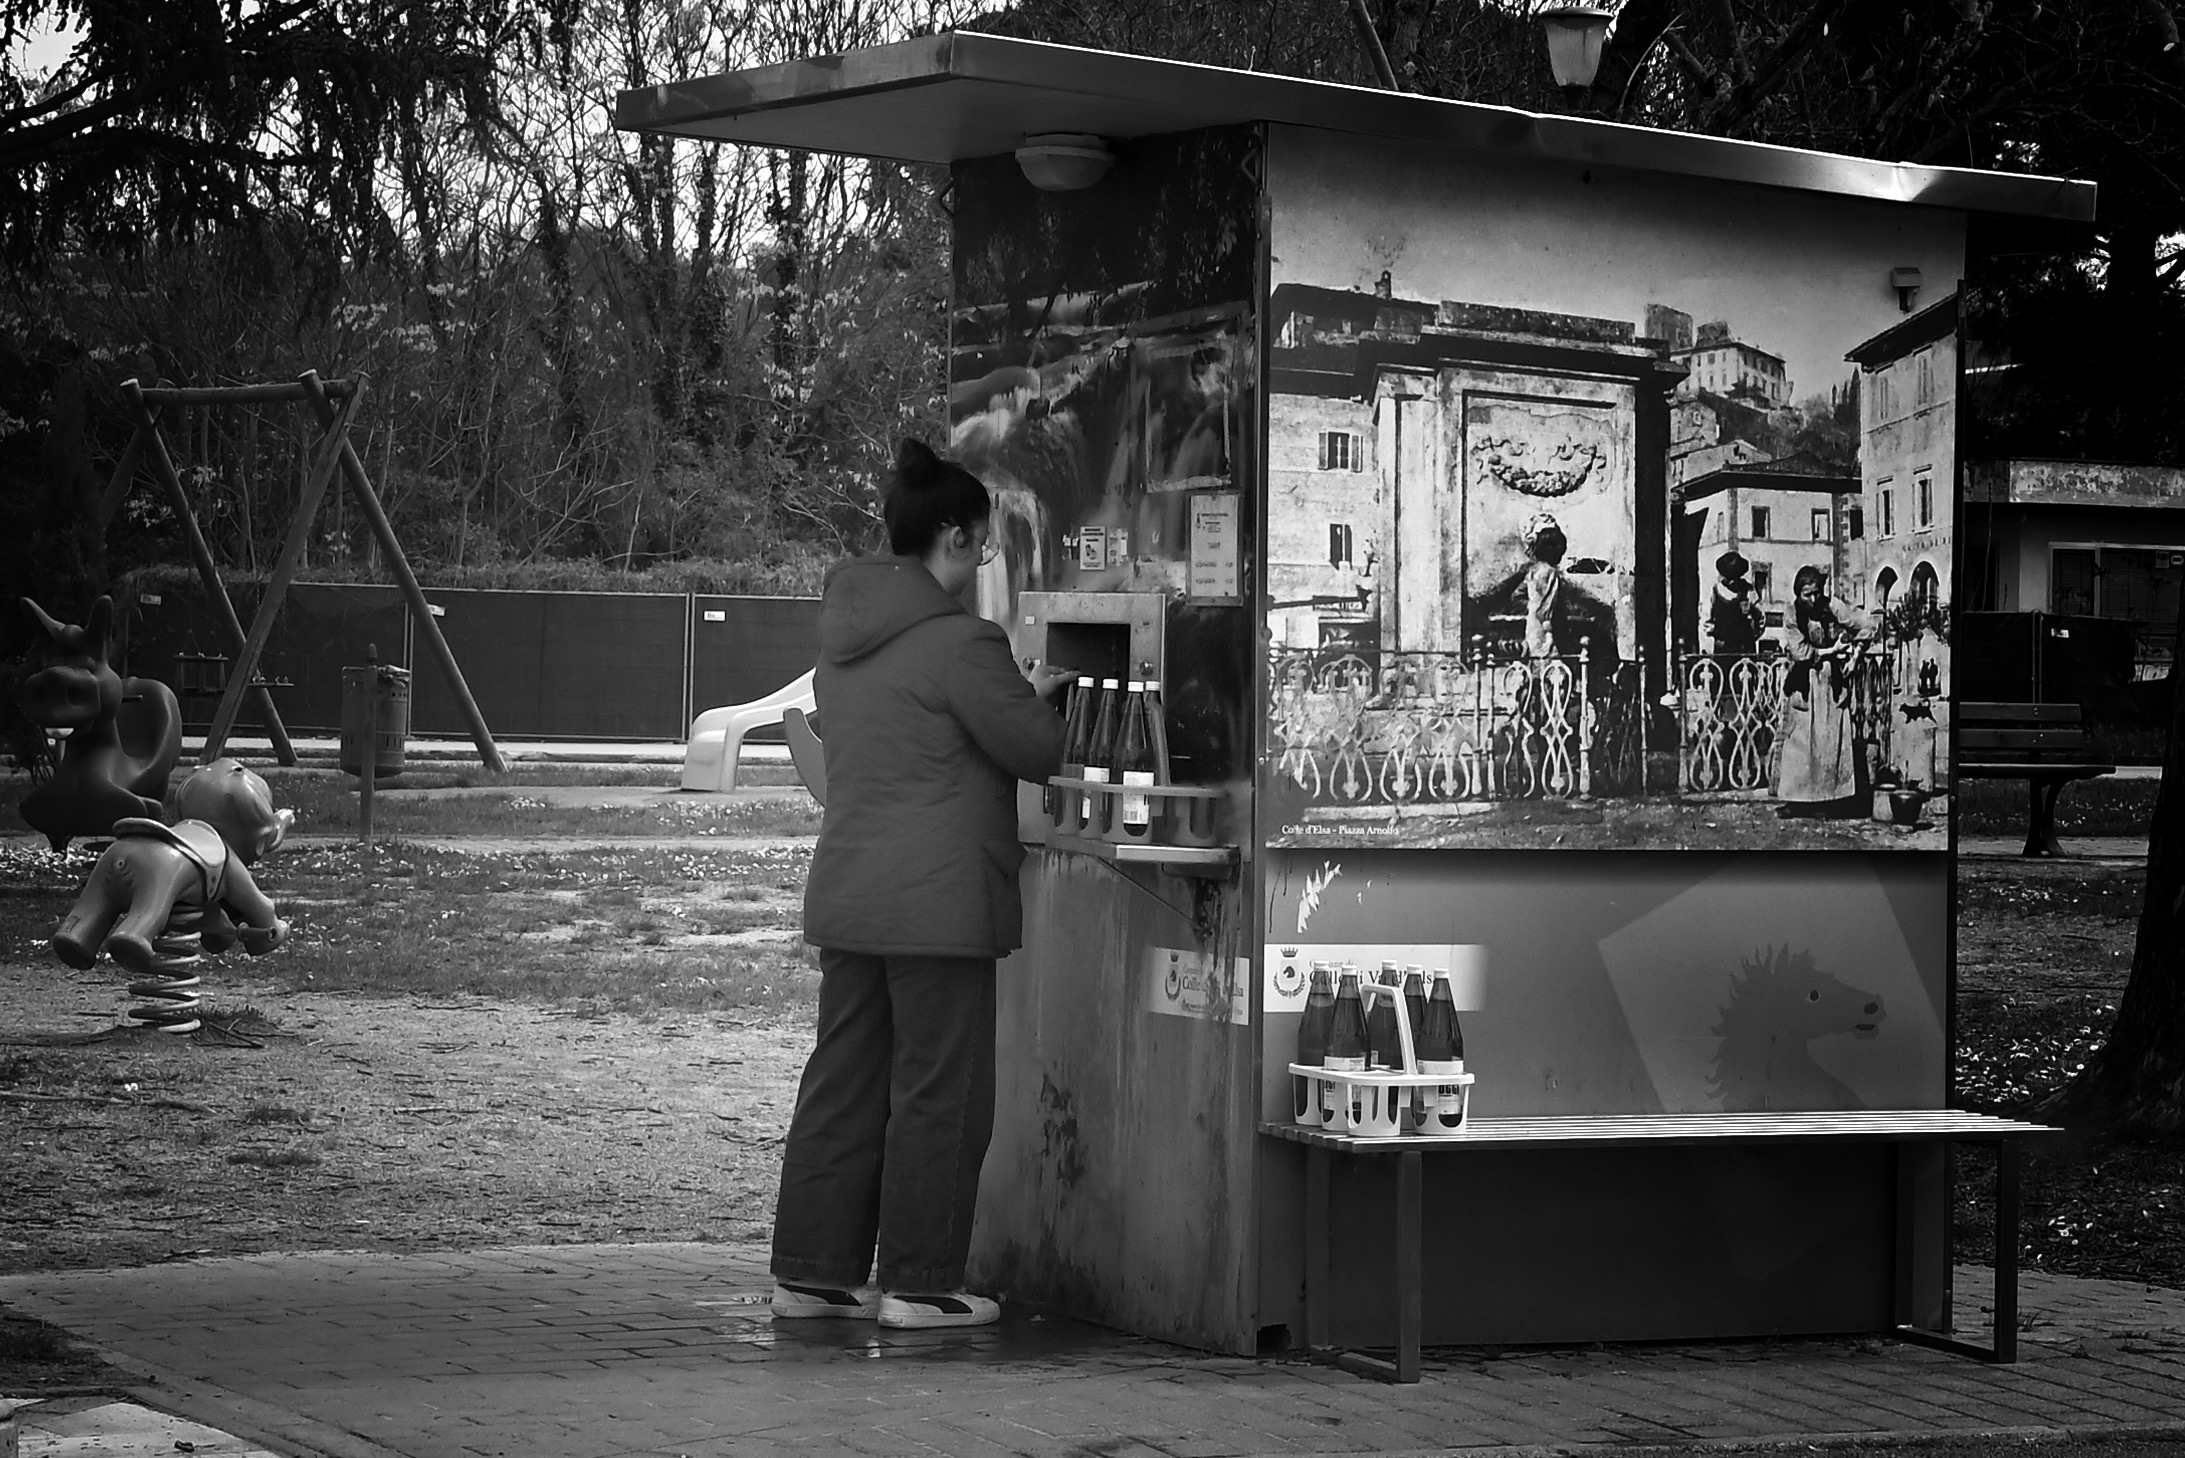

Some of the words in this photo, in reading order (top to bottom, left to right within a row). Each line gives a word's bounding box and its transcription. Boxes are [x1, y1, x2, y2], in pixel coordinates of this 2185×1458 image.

[1305, 824, 1331, 835] d'Elsa
[1338, 824, 1365, 835] Piazza
[1366, 824, 1400, 836] Arnolfo
